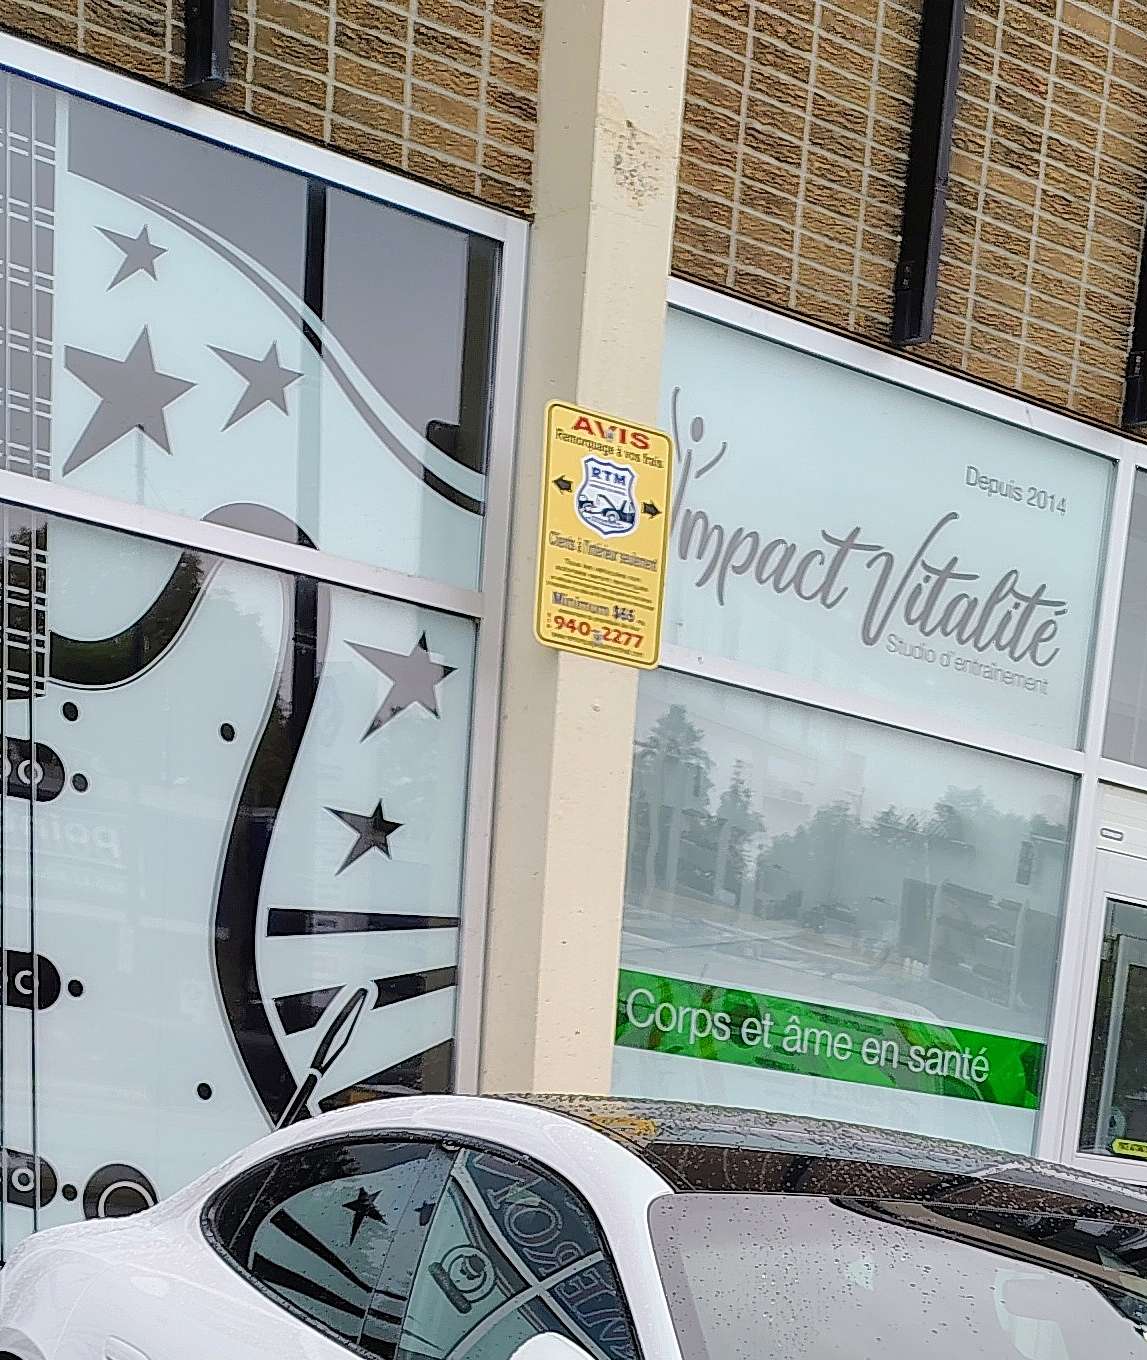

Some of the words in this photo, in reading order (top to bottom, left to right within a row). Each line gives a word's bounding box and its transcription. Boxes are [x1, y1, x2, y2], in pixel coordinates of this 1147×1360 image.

[572, 416, 650, 449] AVIS
[592, 467, 626, 486] RTM
[965, 465, 1023, 501] Depuis
[1027, 486, 1066, 516] 2014
[671, 440, 884, 607] Impact
[861, 511, 1068, 667] Vitalité
[552, 591, 609, 616] Minimum
[886, 633, 936, 663] Studio
[626, 988, 730, 1044] Corps
[741, 1013, 774, 1048] et
[782, 1018, 852, 1061] âme
[861, 1035, 898, 1069] en
[908, 1045, 989, 1083] santé
